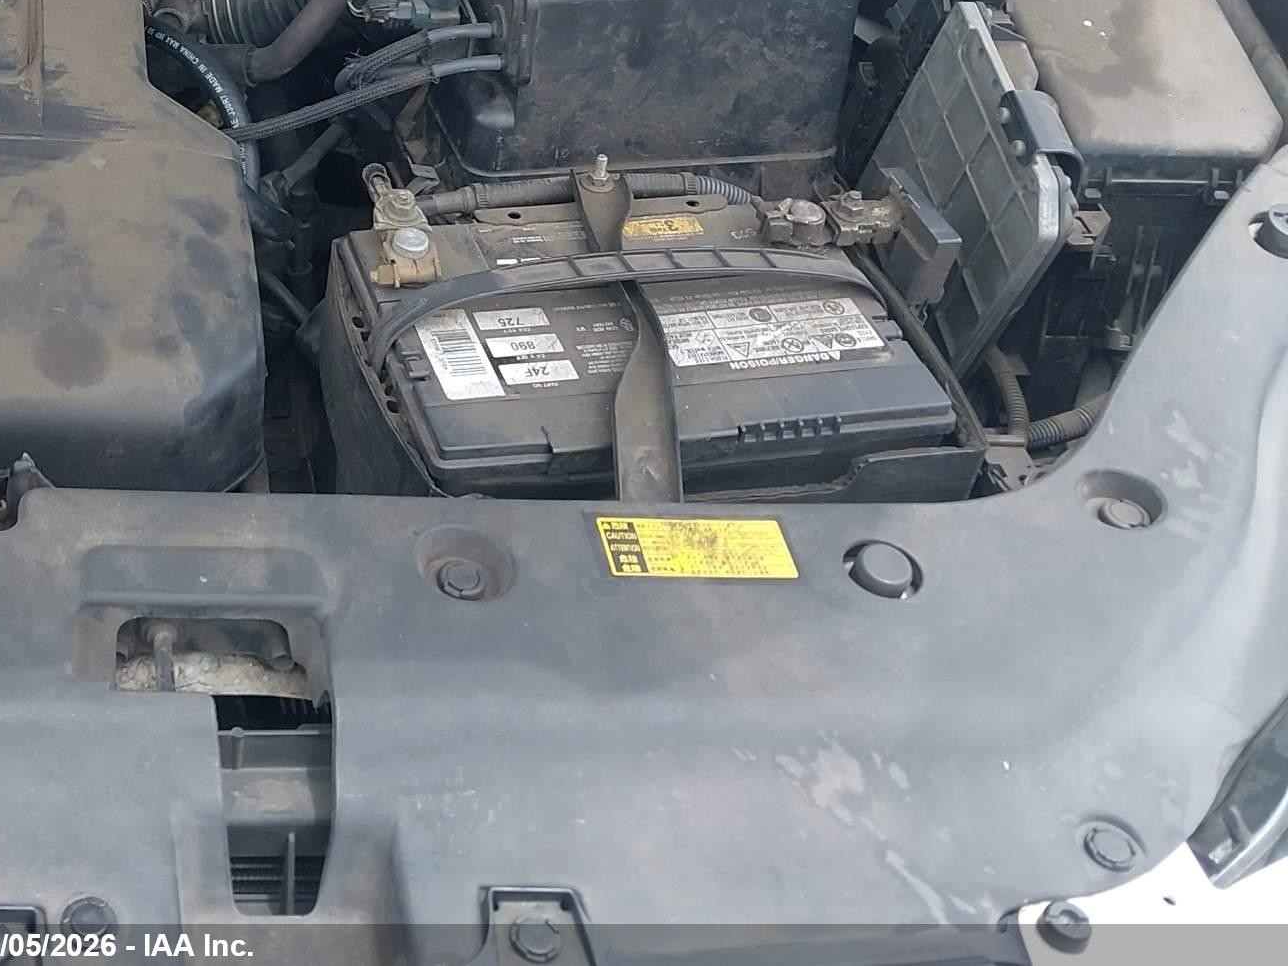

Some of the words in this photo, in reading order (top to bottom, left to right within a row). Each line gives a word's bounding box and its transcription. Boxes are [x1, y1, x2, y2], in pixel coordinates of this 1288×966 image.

[179, 45, 199, 65] CHINA
[197, 63, 208, 73] IN
[205, 71, 223, 94] MADE
[230, 118, 240, 129] AE
[498, 316, 524, 327] 725
[511, 341, 536, 351] 890
[729, 351, 830, 370] DANGER/POISON
[524, 366, 550, 377] 24F
[606, 531, 637, 540] CAUTION
